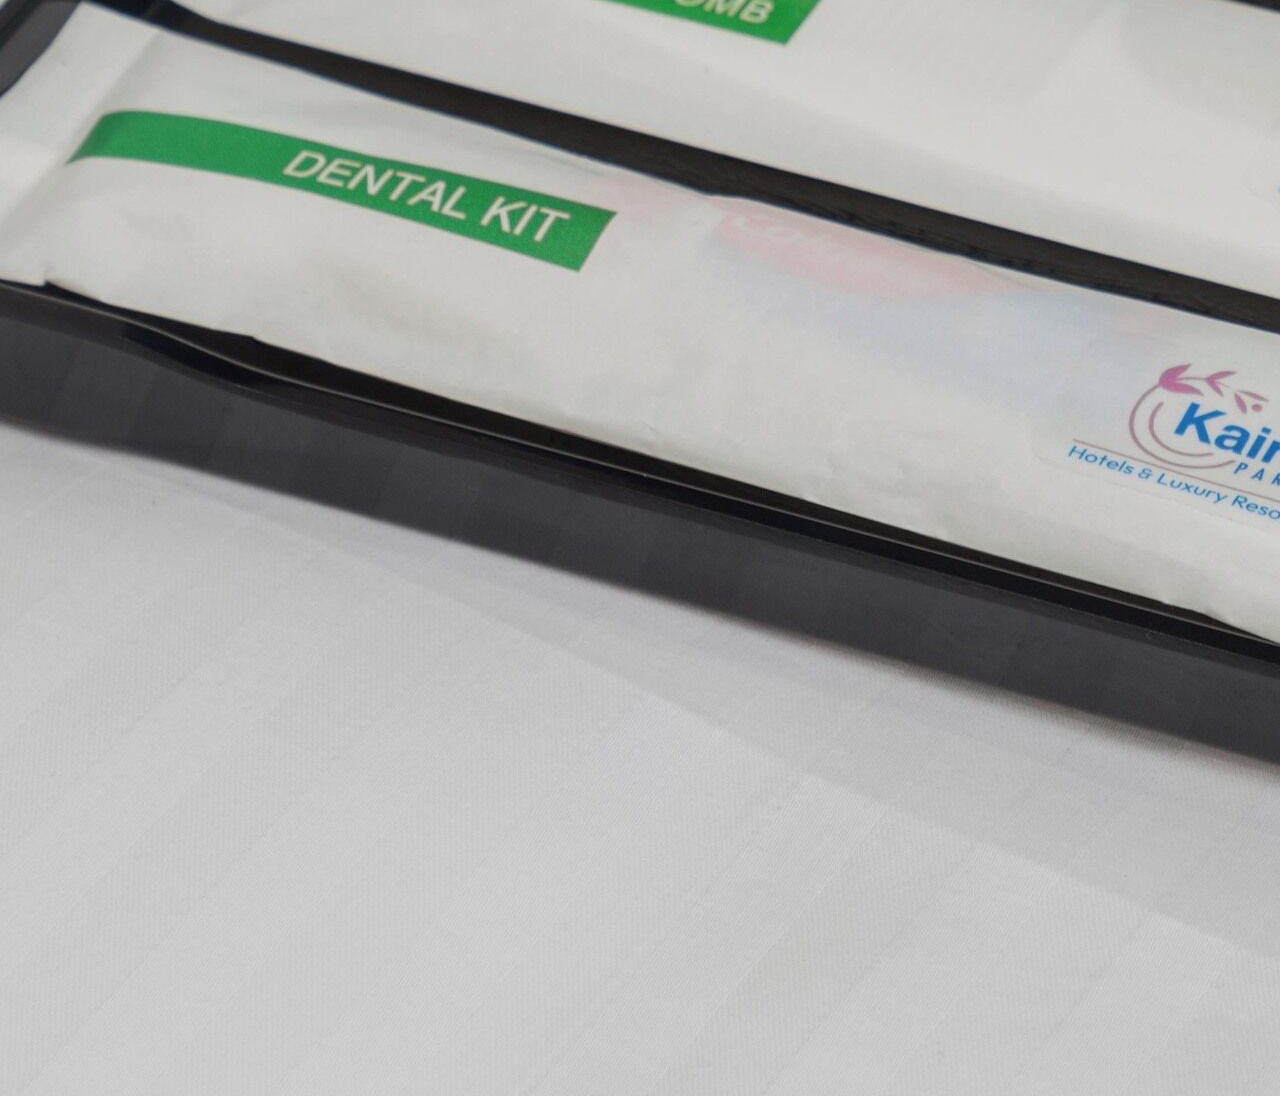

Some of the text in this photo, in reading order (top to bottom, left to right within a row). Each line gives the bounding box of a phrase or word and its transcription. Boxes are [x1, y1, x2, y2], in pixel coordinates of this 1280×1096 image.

[282, 149, 572, 245] DENTAL KIT
[1068, 445, 1134, 476] Hotels
[1137, 467, 1153, 480] &
[1156, 471, 1229, 504] Luxury
